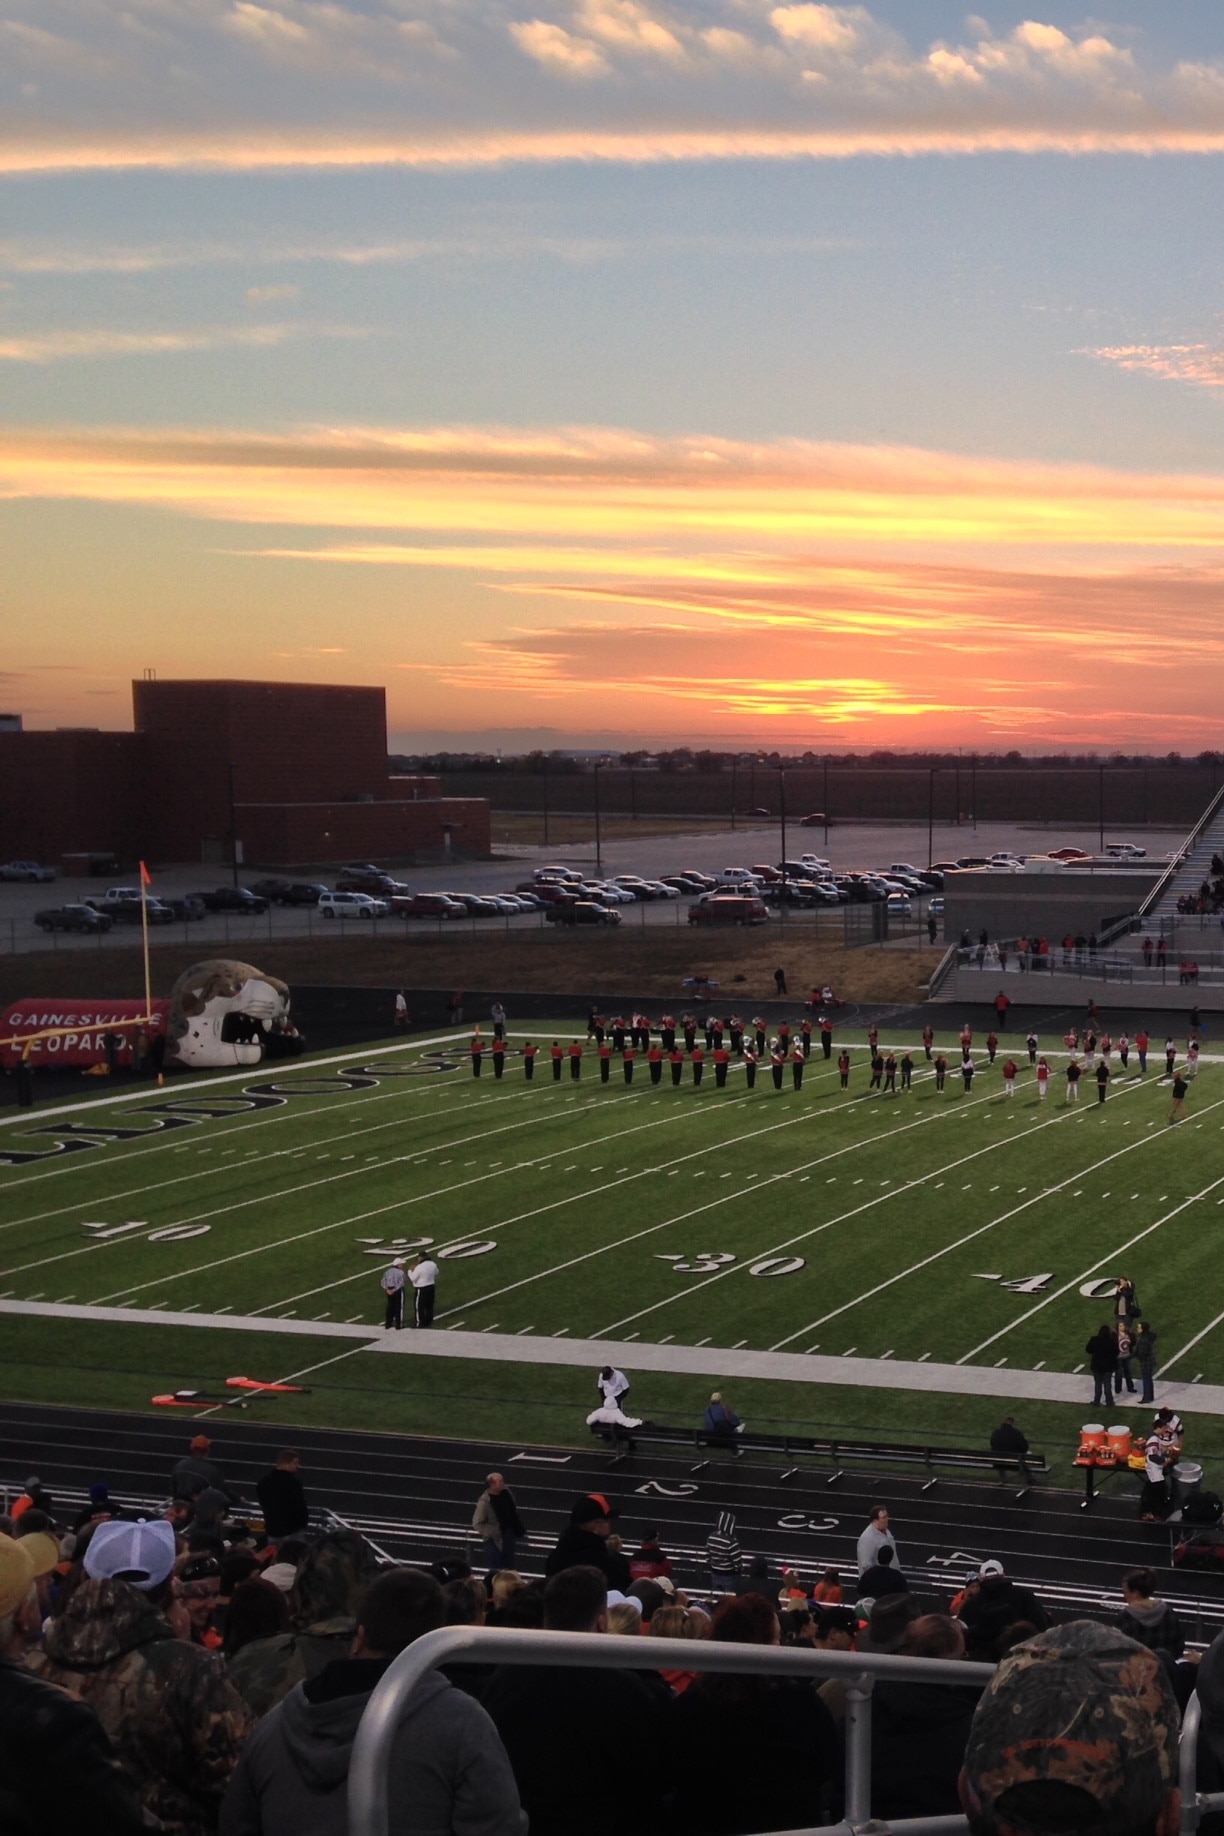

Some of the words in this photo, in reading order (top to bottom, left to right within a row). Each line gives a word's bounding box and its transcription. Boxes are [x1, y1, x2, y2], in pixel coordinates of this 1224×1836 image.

[81, 1220, 212, 1242] 10
[362, 1236, 498, 1260] 20
[671, 1252, 806, 1278] 30
[999, 1272, 1122, 1299] 40
